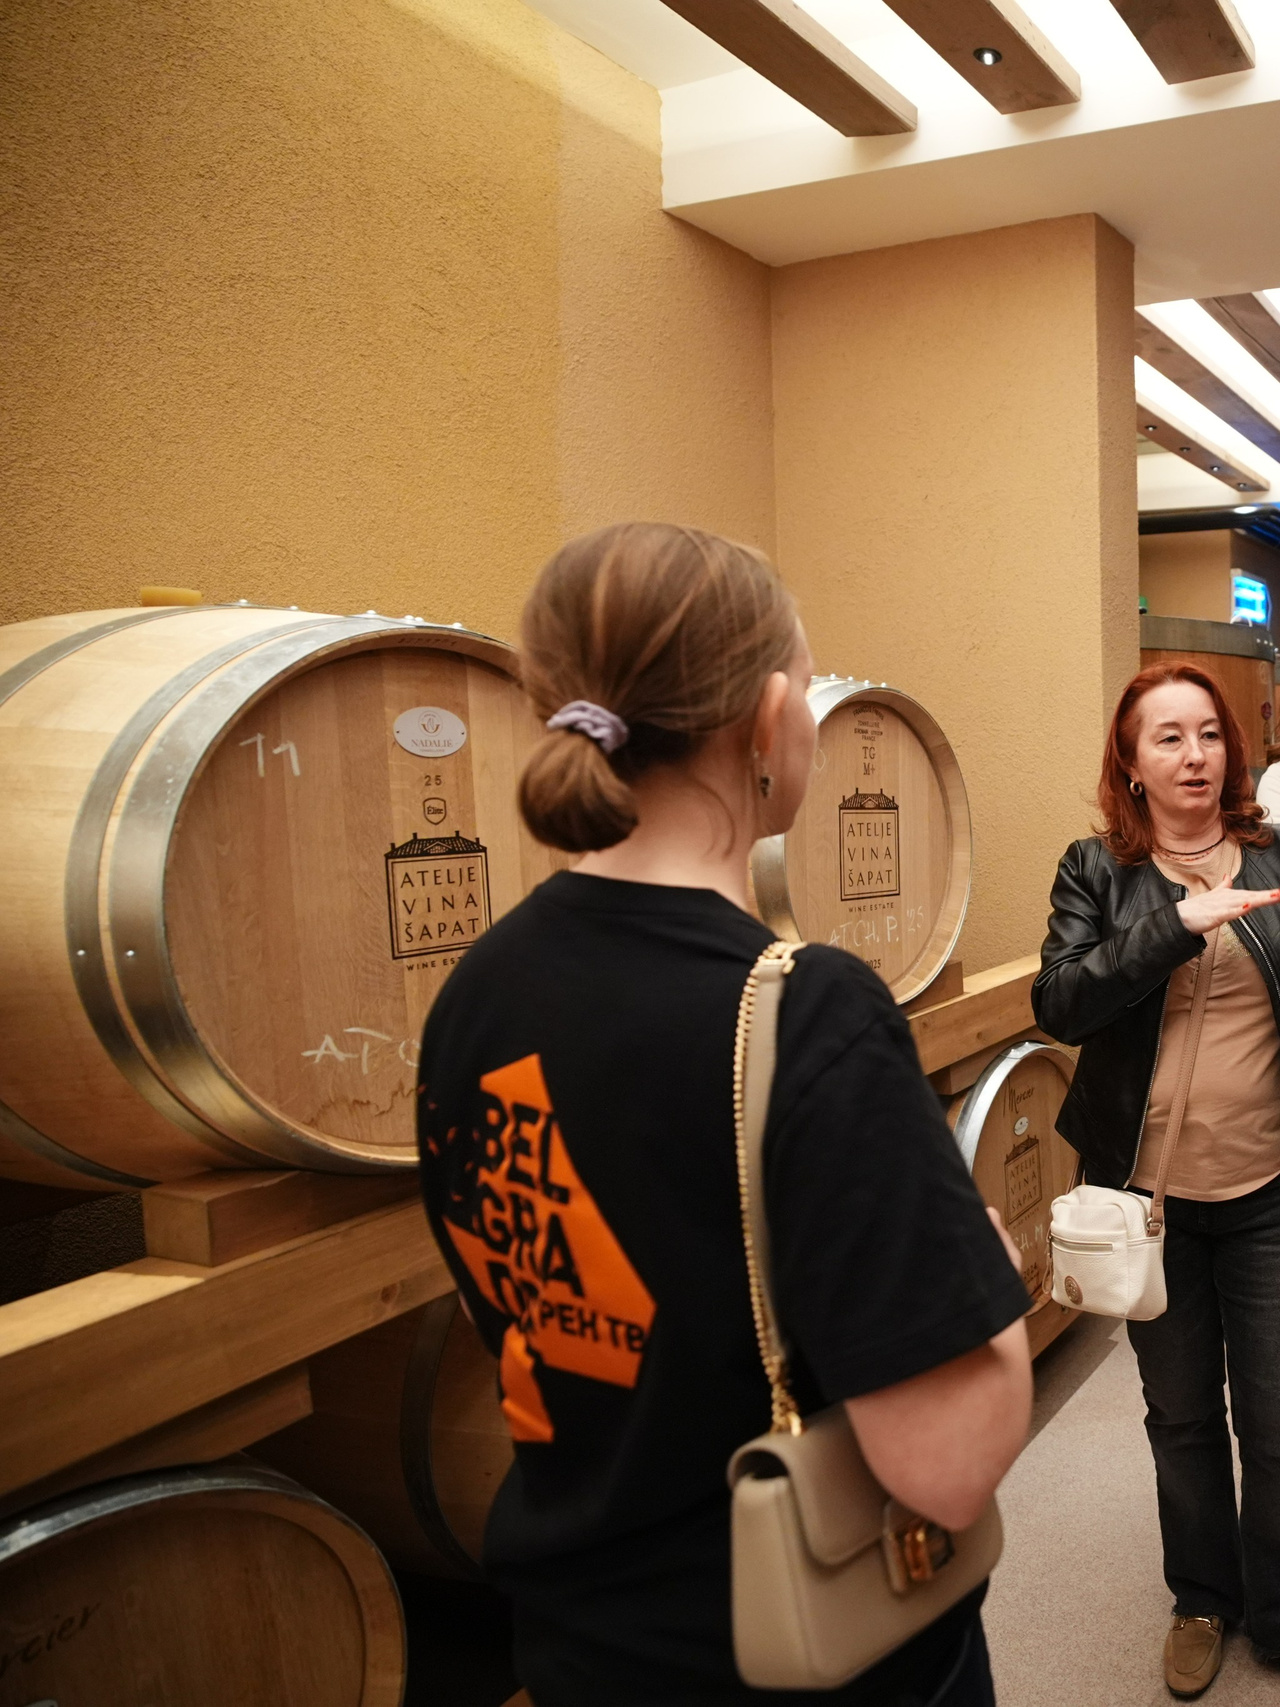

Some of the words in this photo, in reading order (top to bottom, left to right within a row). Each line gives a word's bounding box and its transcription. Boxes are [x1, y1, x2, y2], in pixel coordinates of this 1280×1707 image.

[862, 746, 876, 760] TG
[424, 774, 442, 786] 25
[846, 822, 892, 839] ATELJE
[847, 846, 892, 862] VINA
[400, 866, 477, 889] ATELJE
[848, 869, 893, 887] ŠAPAT
[402, 892, 478, 915] VINA
[869, 901, 894, 911] ESTATE
[404, 917, 479, 943] ŠAPAT
[406, 960, 437, 972] WINE
[1010, 1172, 1037, 1196] VINA
[605, 1316, 645, 1353] ТВ
